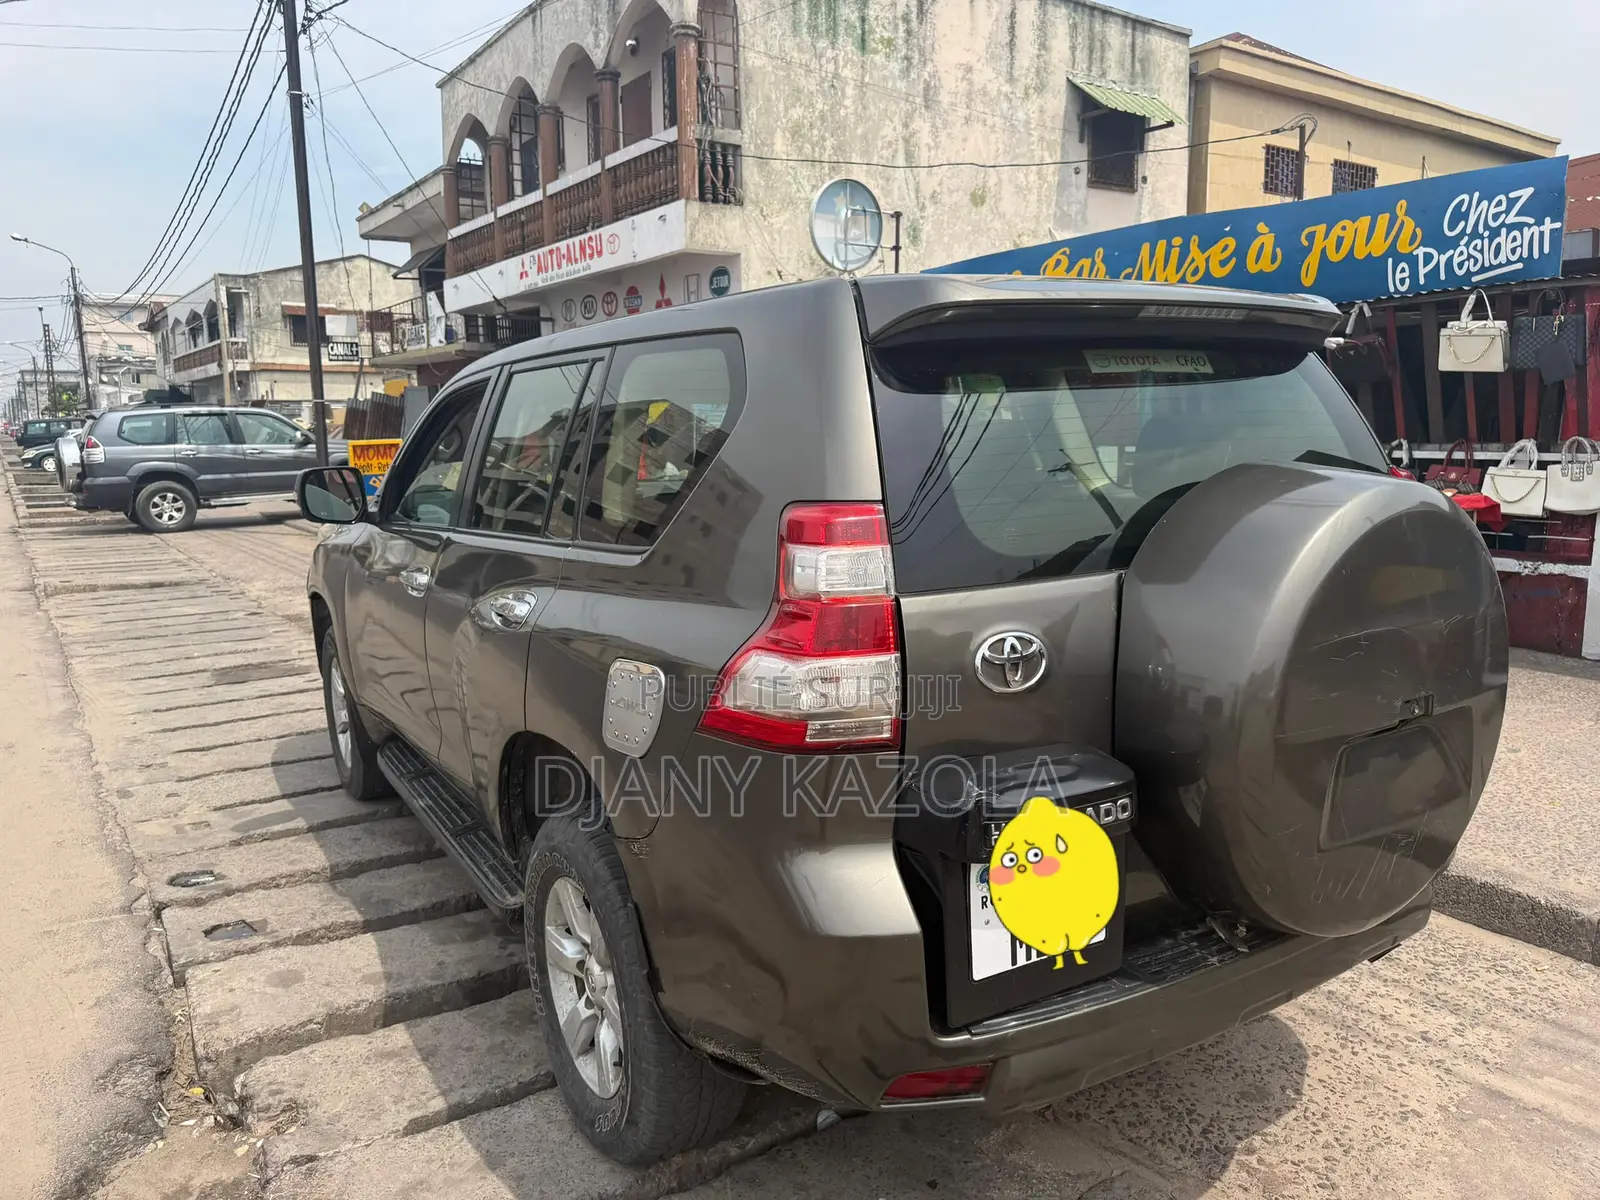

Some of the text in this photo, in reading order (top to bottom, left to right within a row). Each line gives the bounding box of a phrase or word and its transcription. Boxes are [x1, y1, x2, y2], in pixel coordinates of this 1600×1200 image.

[1443, 186, 1535, 237] Chez
[1246, 221, 1283, 274] à
[1388, 216, 1562, 292] le Président
[328, 342, 359, 356] CANAL+
[1114, 355, 1206, 367] TOYOTA CFAO
[1085, 797, 1132, 825] ADO
